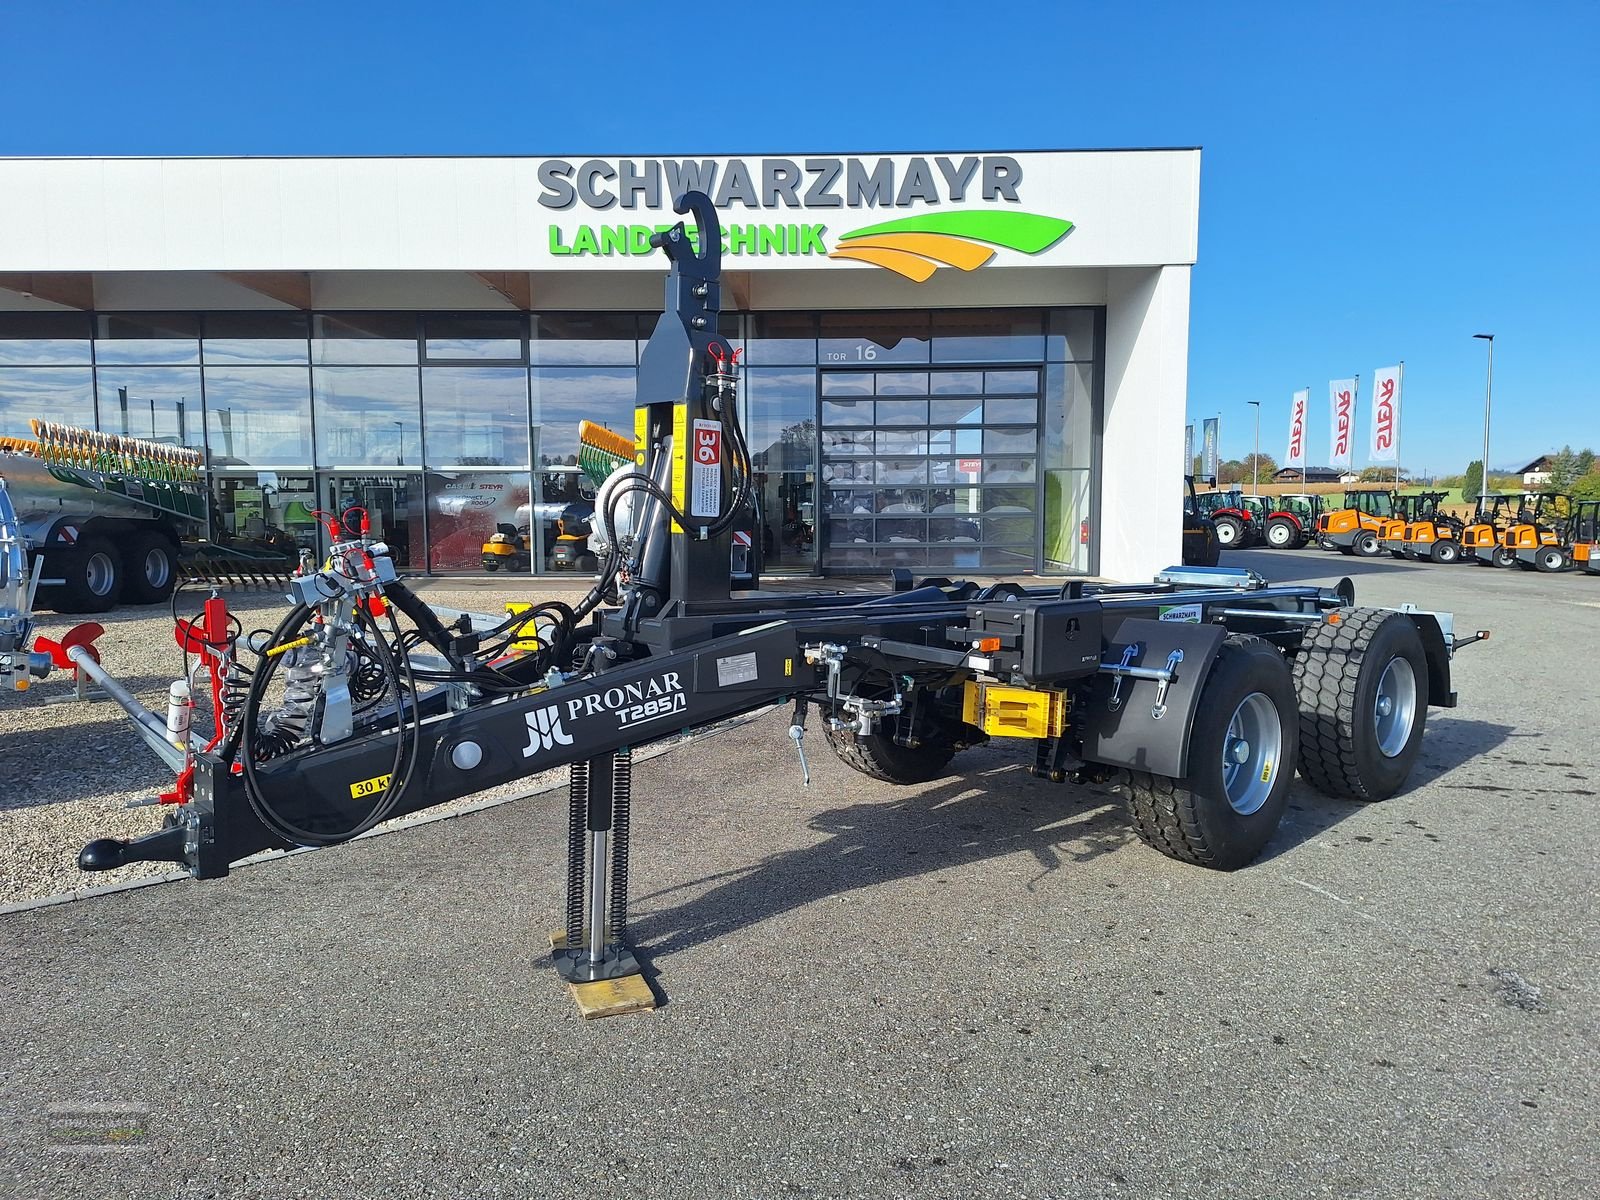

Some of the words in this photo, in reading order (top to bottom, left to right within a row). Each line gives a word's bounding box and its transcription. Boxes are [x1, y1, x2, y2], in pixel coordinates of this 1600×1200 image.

[537, 156, 1022, 208] SCHWARZMAYR
[548, 223, 828, 256] LANDEHNIK
[827, 353, 847, 361] TOR
[855, 345, 877, 361] 16
[699, 431, 716, 461] 36
[1162, 611, 1197, 620] SCHWARZMAYR
[565, 671, 684, 721] PRONAR
[614, 692, 688, 724] T285/1
[356, 782, 373, 795] 30
